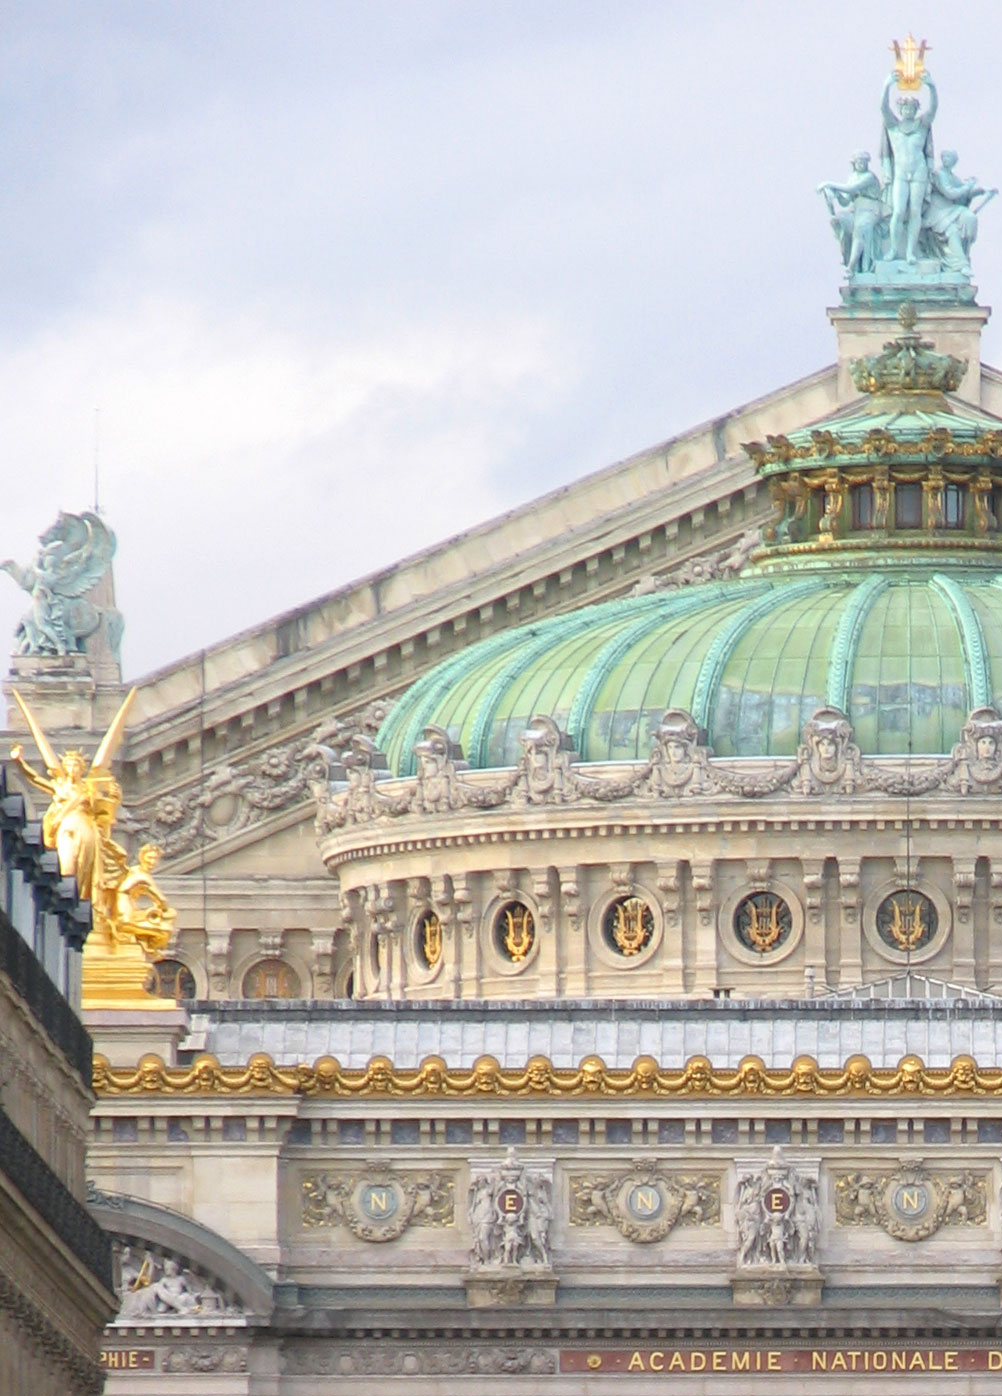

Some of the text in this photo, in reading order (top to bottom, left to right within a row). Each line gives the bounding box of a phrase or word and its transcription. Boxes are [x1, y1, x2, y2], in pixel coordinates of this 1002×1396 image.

[371, 1192, 386, 1211] N
[505, 1195, 518, 1210] E
[637, 1192, 653, 1210] N
[771, 1194, 783, 1210] E
[903, 1191, 918, 1209] N
[628, 1351, 782, 1371] ACADEMIE
[811, 1351, 959, 1371] NATIONALE
